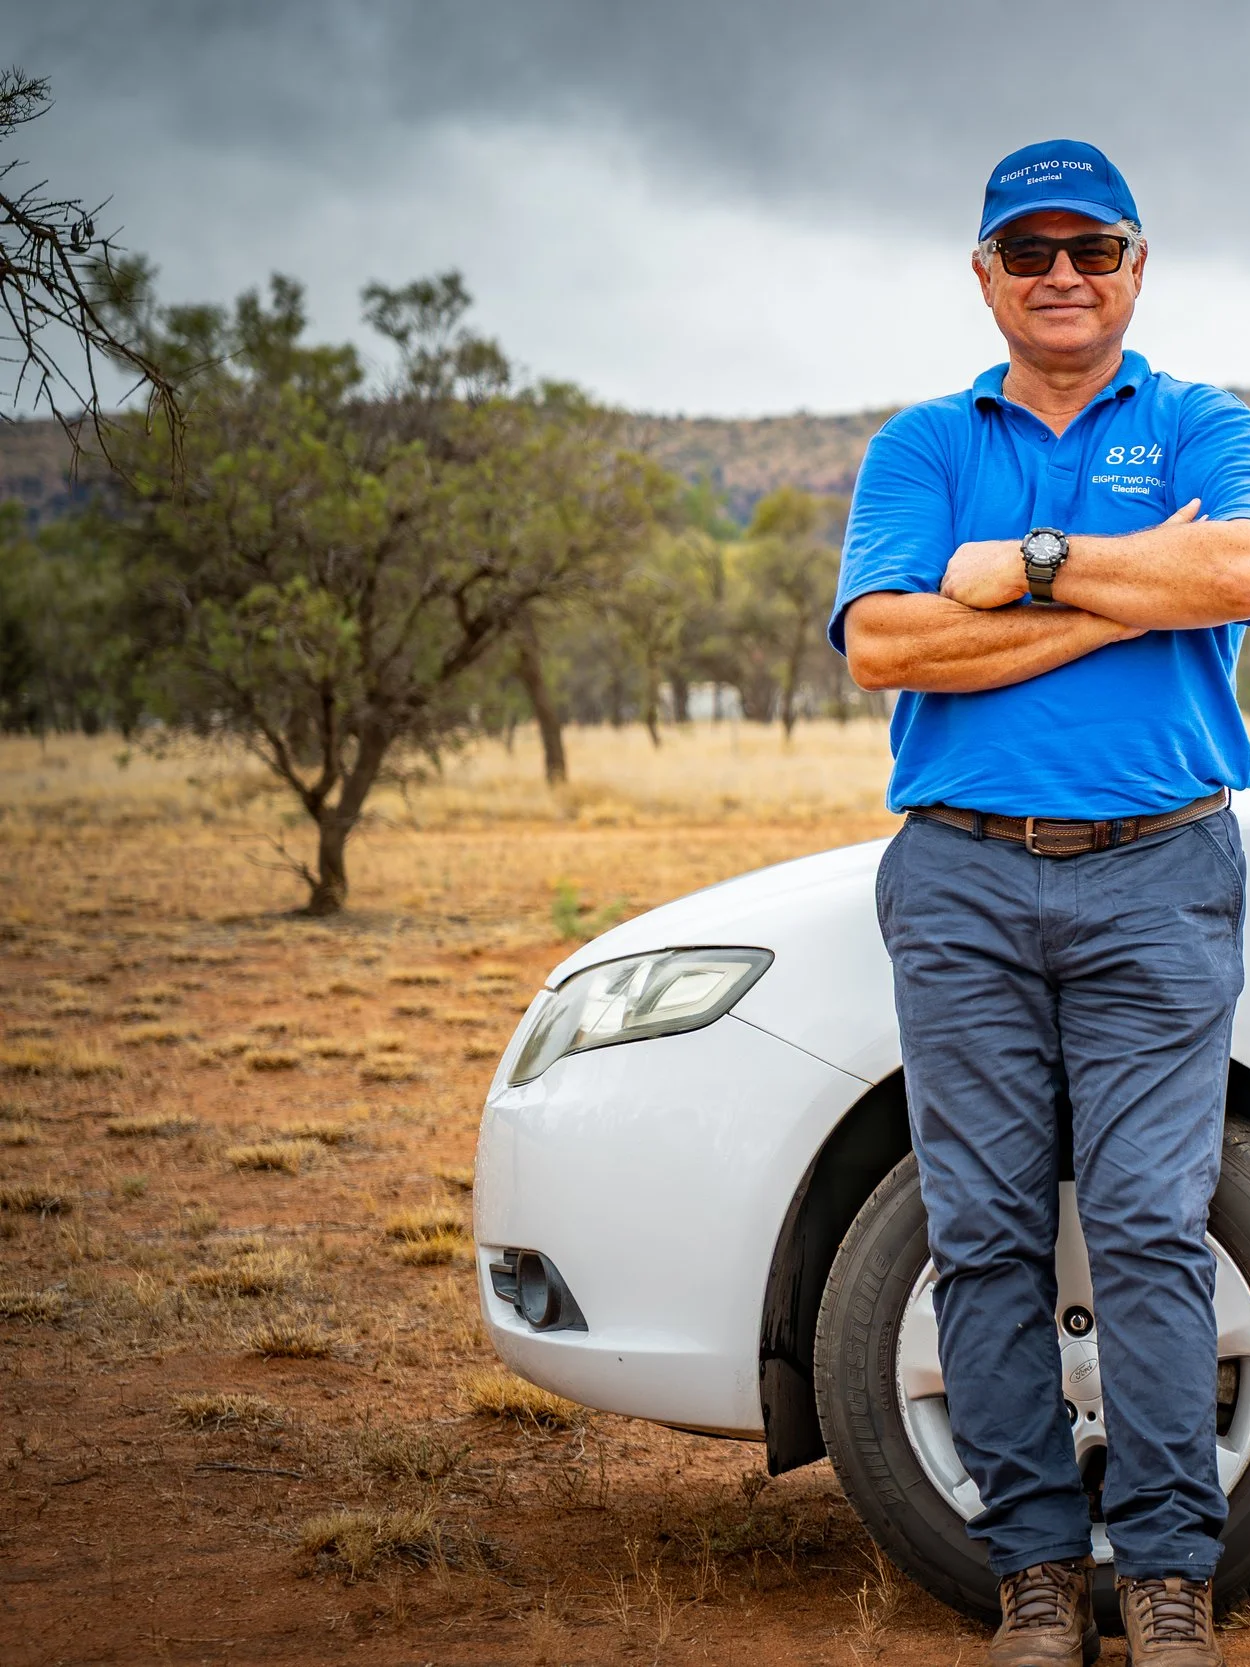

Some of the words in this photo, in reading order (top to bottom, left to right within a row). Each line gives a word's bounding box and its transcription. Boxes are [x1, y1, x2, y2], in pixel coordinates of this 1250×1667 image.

[1000, 167, 1031, 183] EIGHT
[1033, 160, 1059, 171] TWO
[1062, 161, 1093, 172] FOUR
[1027, 173, 1062, 185] Electrical
[1105, 443, 1163, 465] 824
[1092, 475, 1120, 483] EIGHT
[1121, 476, 1144, 484] TWO
[1112, 484, 1149, 494] Electrical
[848, 1249, 904, 1505] BRIDGESTONE
